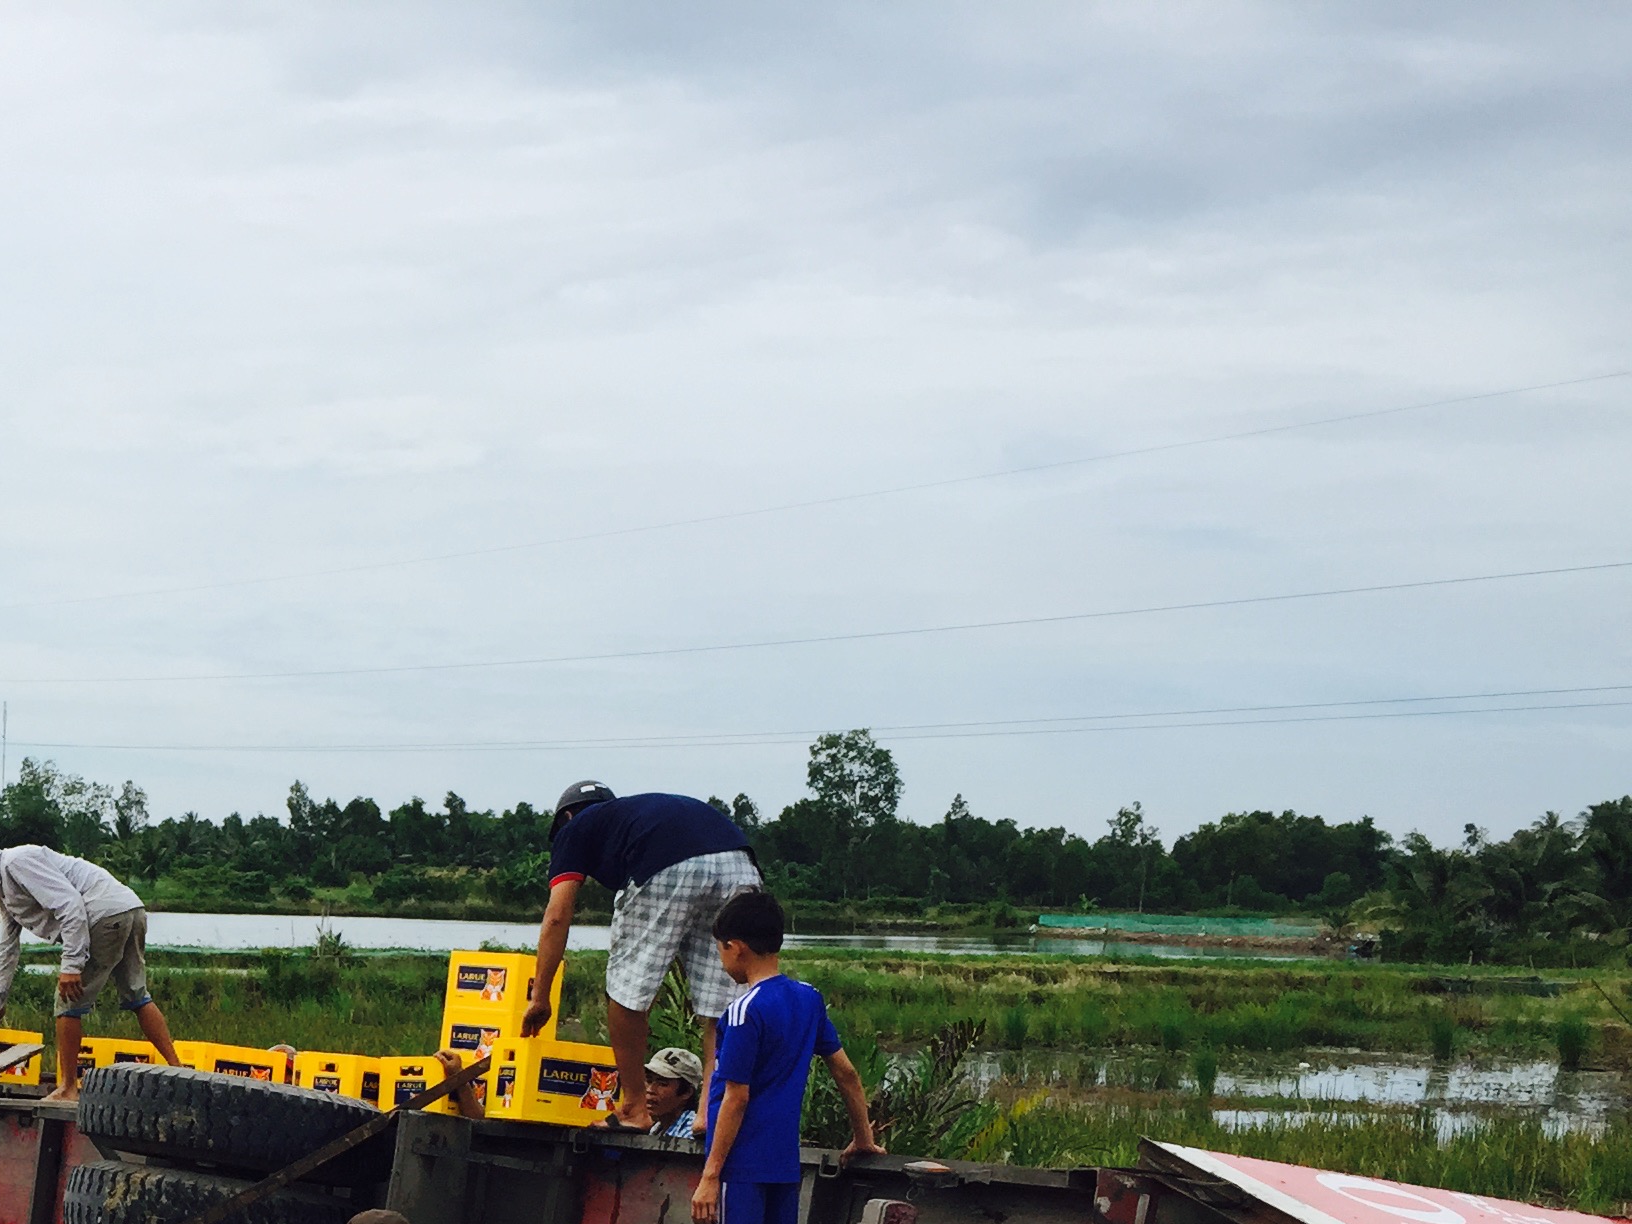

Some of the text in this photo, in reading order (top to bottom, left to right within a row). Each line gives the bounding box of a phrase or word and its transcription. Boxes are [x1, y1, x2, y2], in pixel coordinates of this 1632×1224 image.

[459, 972, 487, 981] LARUE
[452, 1032, 479, 1041] LARUE
[543, 1067, 588, 1083] LARUE
